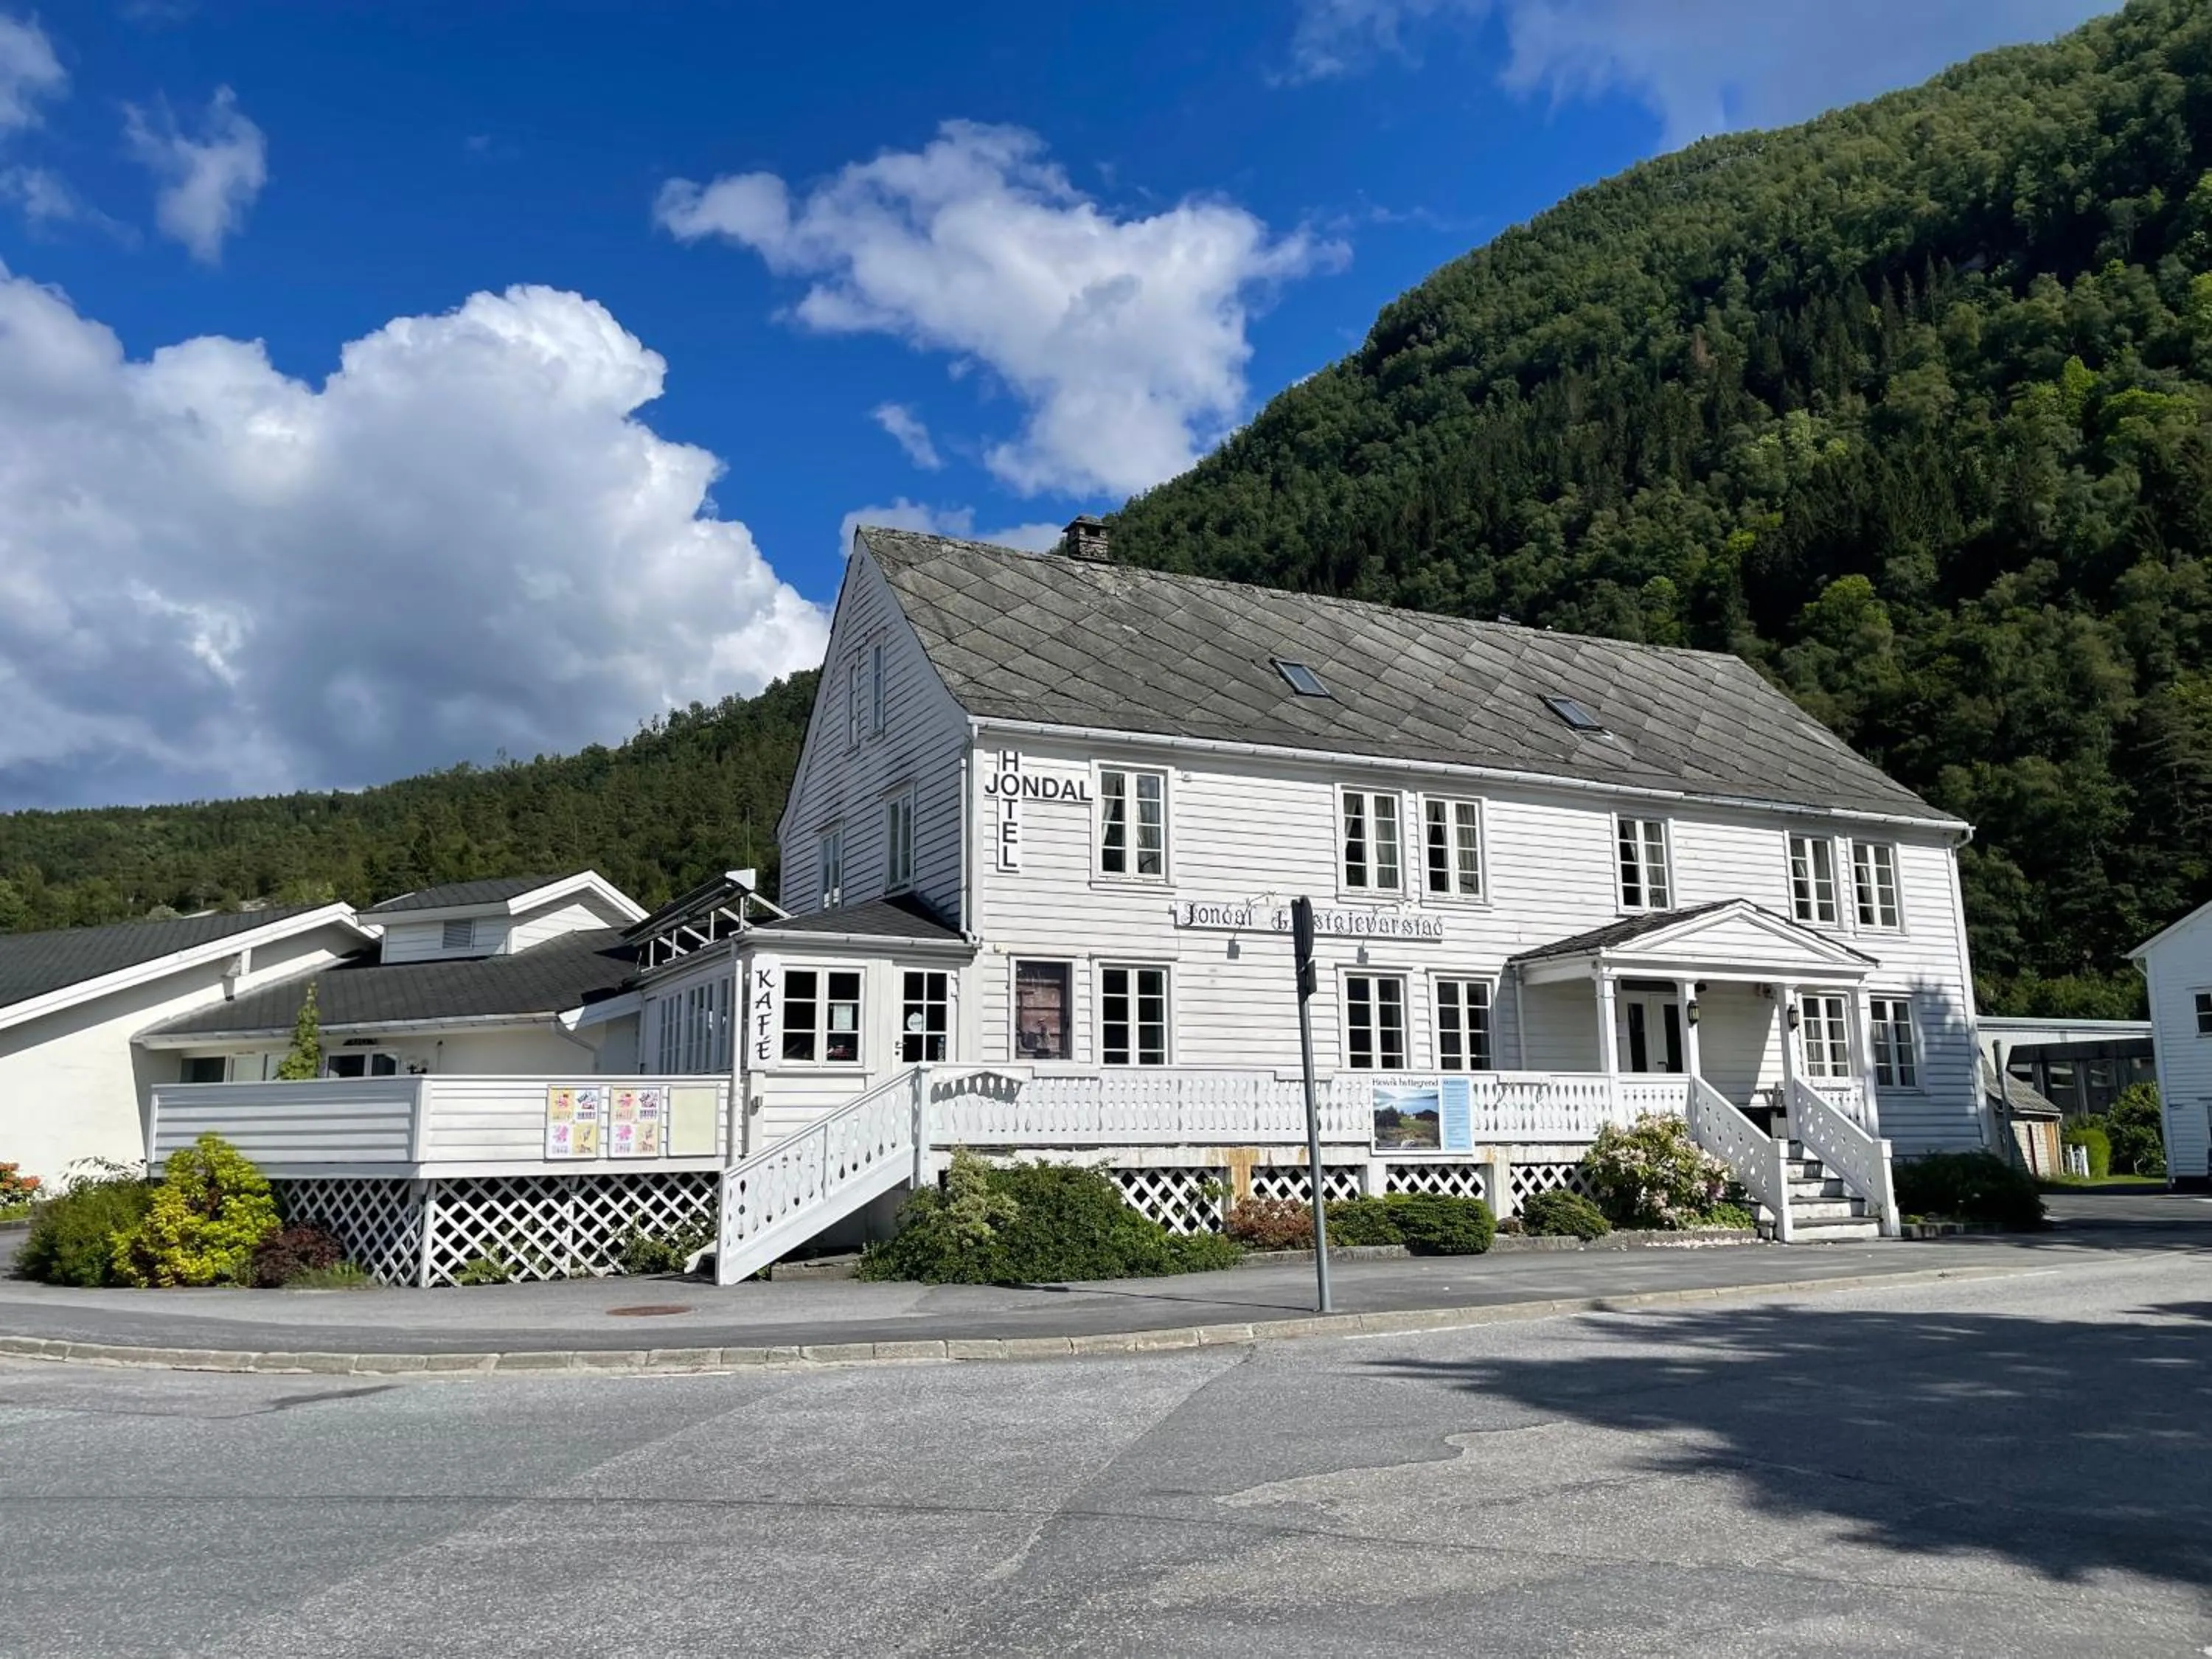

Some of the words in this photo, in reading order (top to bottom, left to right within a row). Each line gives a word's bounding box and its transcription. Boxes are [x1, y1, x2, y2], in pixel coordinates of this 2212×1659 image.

[984, 773, 1093, 801] JONDAL
[1001, 750, 1020, 867] HOTEL
[1181, 902, 1256, 927] Jondal
[1271, 907, 1444, 936] Gstgjevarstad
[755, 969, 776, 1060] KAFÉ
